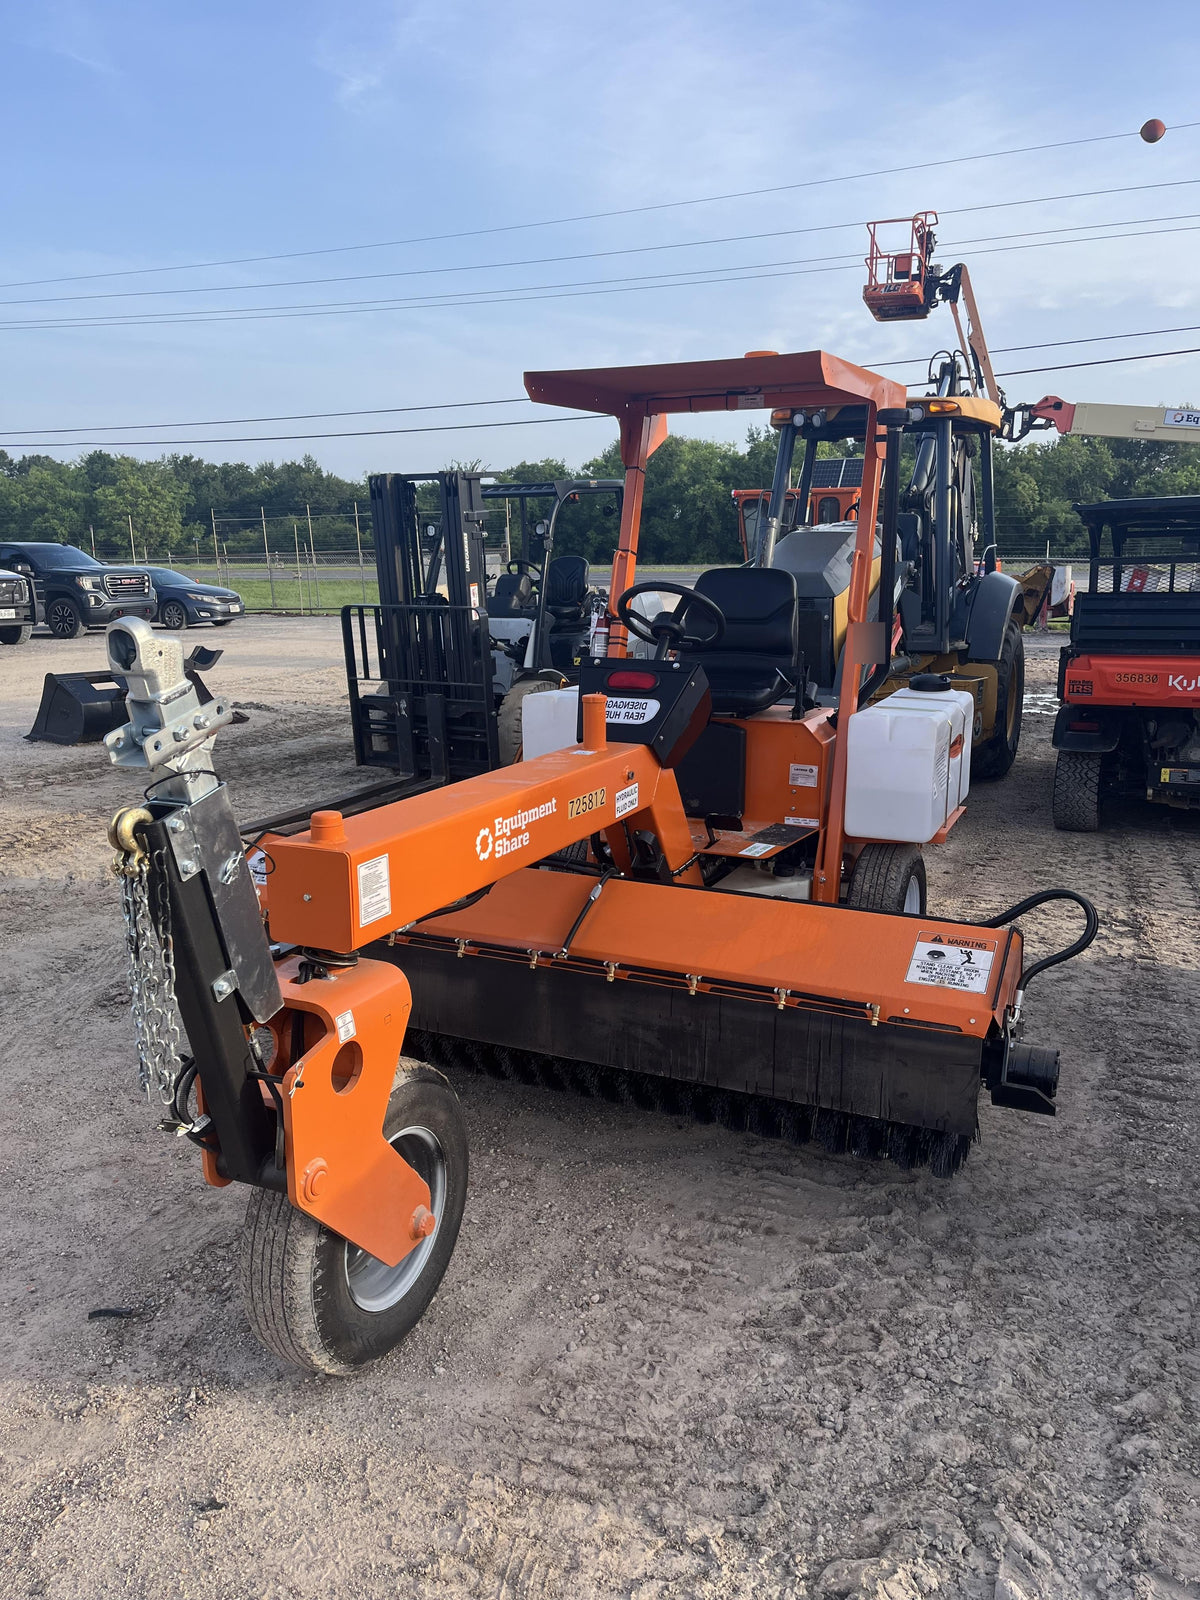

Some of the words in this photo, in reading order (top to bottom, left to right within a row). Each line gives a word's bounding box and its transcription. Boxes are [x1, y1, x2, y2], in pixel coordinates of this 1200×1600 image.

[1115, 673, 1159, 683] 356830
[1168, 675, 1200, 691] Ku
[1069, 685, 1093, 693] IRS
[616, 786, 638, 802] HYDRAULIC
[568, 788, 605, 818] 725812
[616, 803, 627, 814] FLUID
[627, 798, 637, 808] ONLY
[494, 798, 557, 837] Equipment
[494, 832, 530, 858] Share
[947, 938, 987, 949] WARNING
